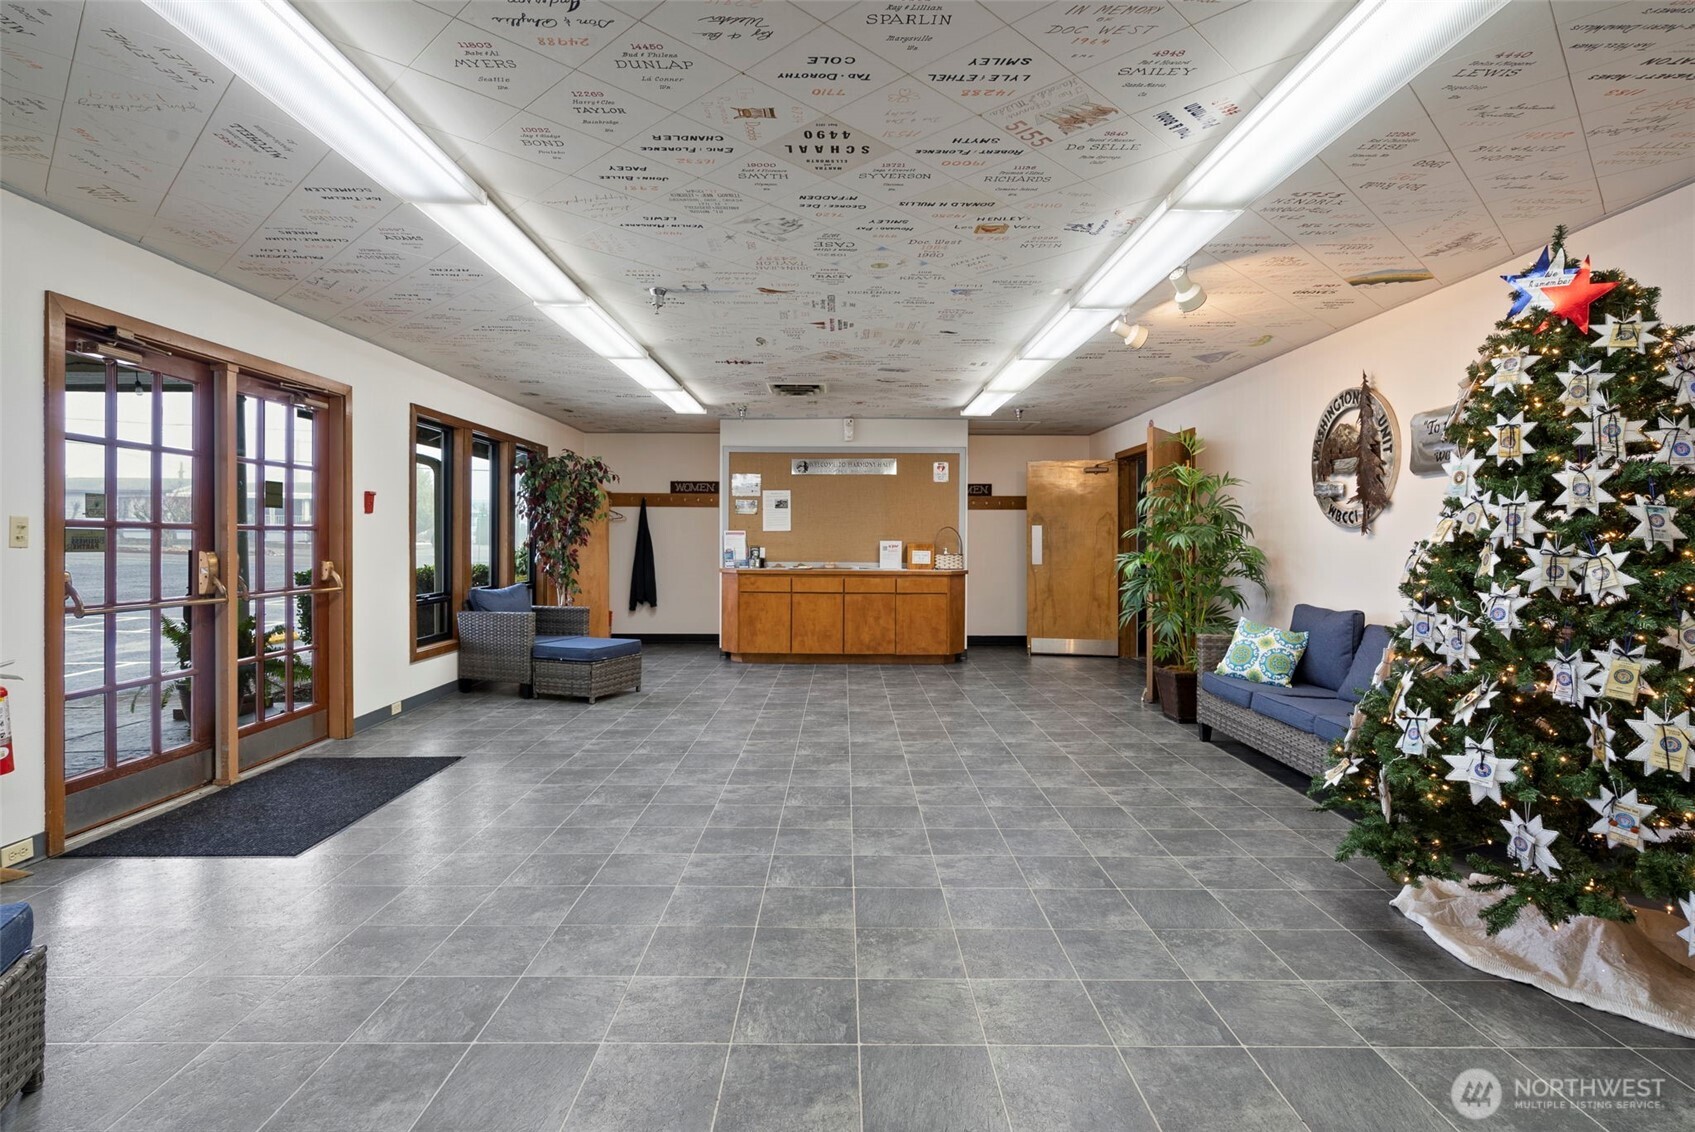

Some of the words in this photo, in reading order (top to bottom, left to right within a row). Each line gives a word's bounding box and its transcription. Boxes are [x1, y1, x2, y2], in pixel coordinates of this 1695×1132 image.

[1064, 5, 1091, 15] IN
[1092, 5, 1165, 15] MEMORY
[866, 14, 952, 26] SPARLIN
[1044, 25, 1088, 34] DOC
[1098, 25, 1159, 34] WEST
[455, 58, 517, 68] MYERS
[807, 56, 856, 64] COLE
[968, 58, 1032, 66] SMILEY
[614, 60, 694, 70] DUNLAP
[1118, 67, 1198, 76] SMILEY
[1452, 68, 1522, 78] LEWIS
[778, 73, 838, 81] DOROTHY
[928, 74, 978, 82] ETHEL
[992, 74, 1032, 82] LYLE
[811, 88, 846, 96] 7710
[803, 131, 851, 140] 4490
[1006, 120, 1053, 147] 5155
[784, 145, 870, 154] SCHAAL
[1313, 390, 1362, 462] WASHINGTON
[1378, 414, 1393, 453] UNIT
[675, 482, 716, 492] WOMEN
[1328, 504, 1358, 524] WBCCI
